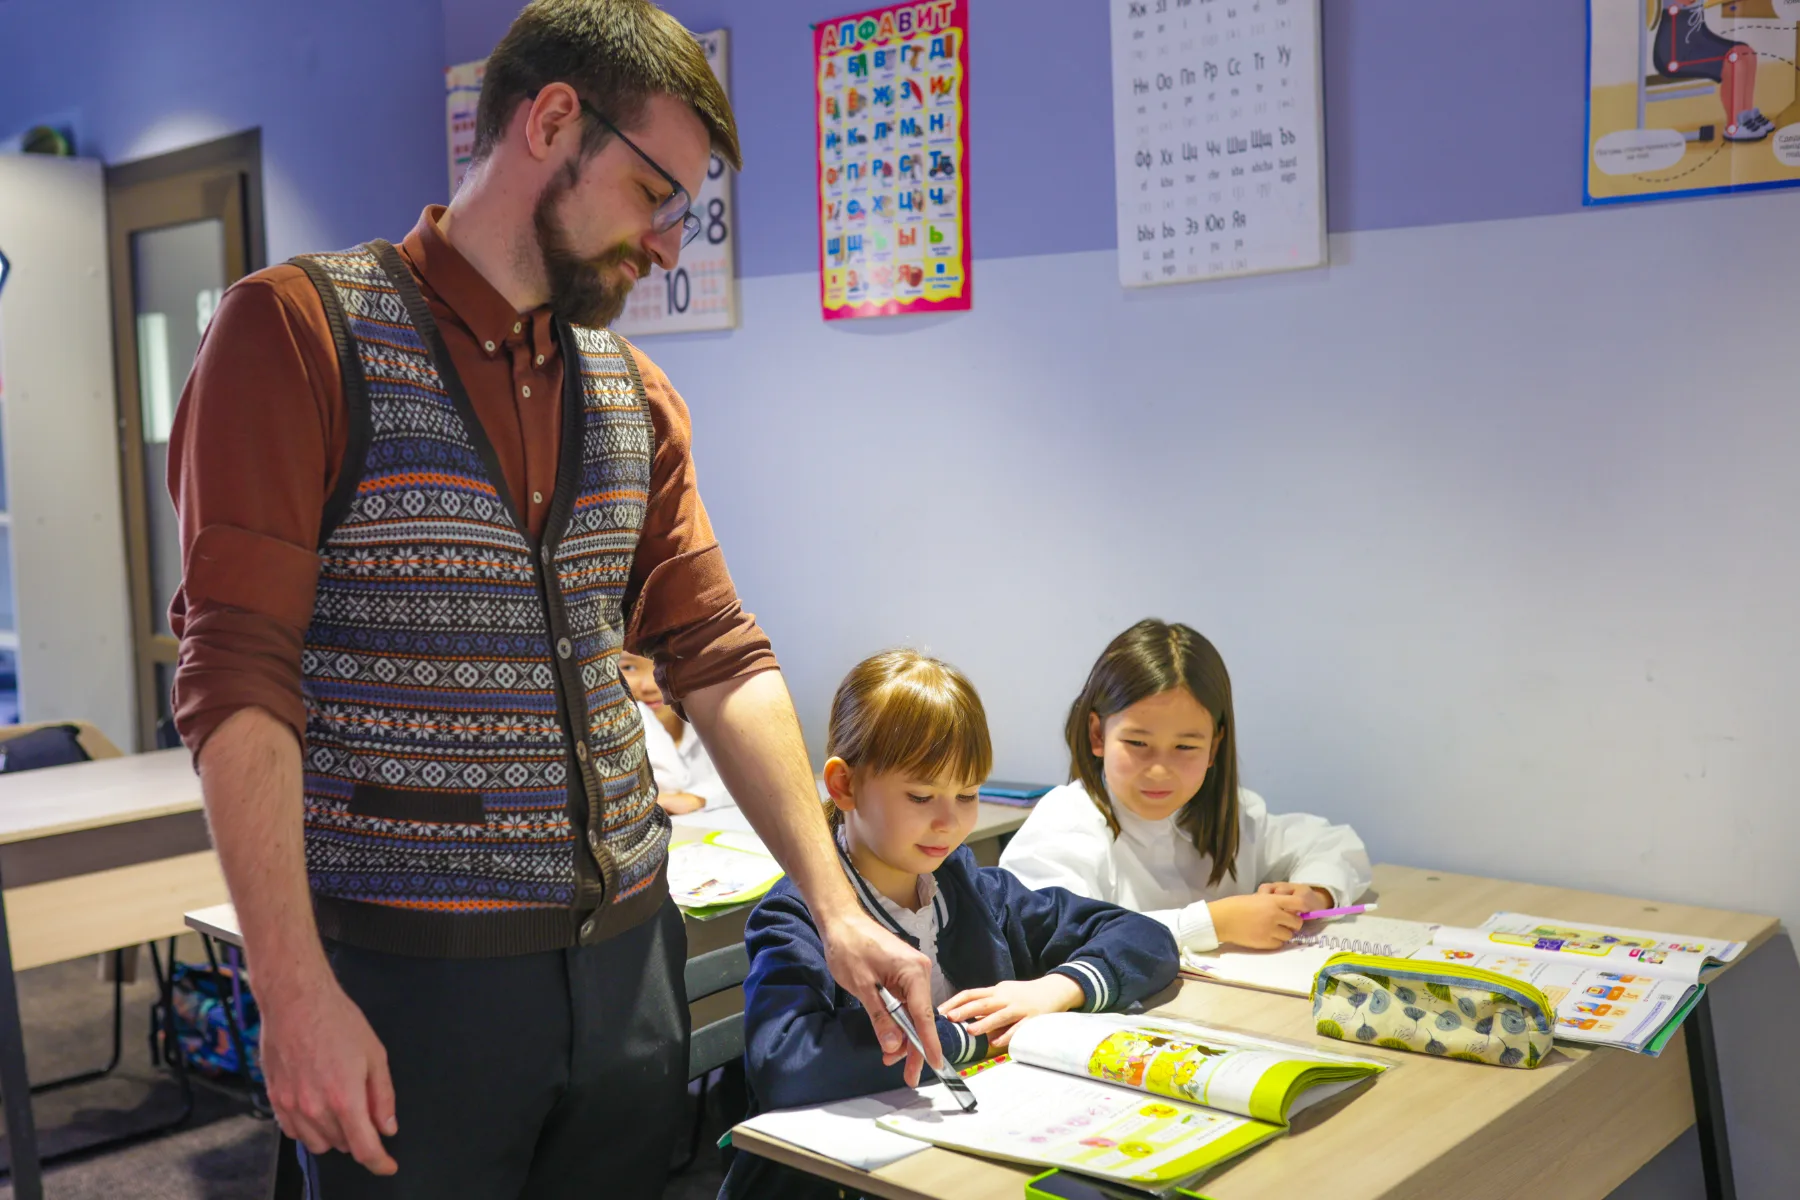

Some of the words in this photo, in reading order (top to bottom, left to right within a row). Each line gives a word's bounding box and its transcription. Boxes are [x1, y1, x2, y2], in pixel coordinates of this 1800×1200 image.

[824, 2, 952, 49] АЛФАВИТ
[826, 61, 835, 77] А
[848, 56, 860, 73] Б
[874, 50, 886, 68] В
[900, 44, 912, 62] Г
[929, 38, 945, 60] Д
[1133, 77, 1149, 95] Нн
[1156, 72, 1173, 91] Оо
[1180, 68, 1196, 86] Пп
[1203, 61, 1218, 84] Рр
[1227, 57, 1242, 76] Сс
[1253, 51, 1265, 71] Тт
[1277, 44, 1291, 68] Уу
[826, 96, 835, 115] Е
[873, 85, 891, 104] Ж
[900, 81, 911, 99] З
[929, 75, 944, 95] И
[847, 128, 859, 146] К
[874, 122, 887, 140] Л
[900, 117, 915, 136] М
[930, 113, 944, 132] Н
[826, 167, 837, 185] О
[847, 163, 859, 180] П
[873, 159, 883, 176] Р
[899, 155, 911, 173] С
[929, 151, 943, 169] Т
[1135, 150, 1152, 171] Фф
[1160, 148, 1173, 166] Хх
[1182, 141, 1198, 162] Цц
[1206, 140, 1220, 157] Чч
[1227, 136, 1247, 154] Шш
[872, 195, 884, 212] Х
[899, 192, 913, 211] Ц
[929, 188, 944, 205] Ч
[707, 198, 727, 244] 8
[1205, 214, 1225, 232] Юю
[1233, 210, 1247, 228] Яя
[827, 238, 840, 255] Ш
[898, 227, 916, 247] Ы
[929, 225, 944, 244] Ь
[664, 267, 691, 316] 10
